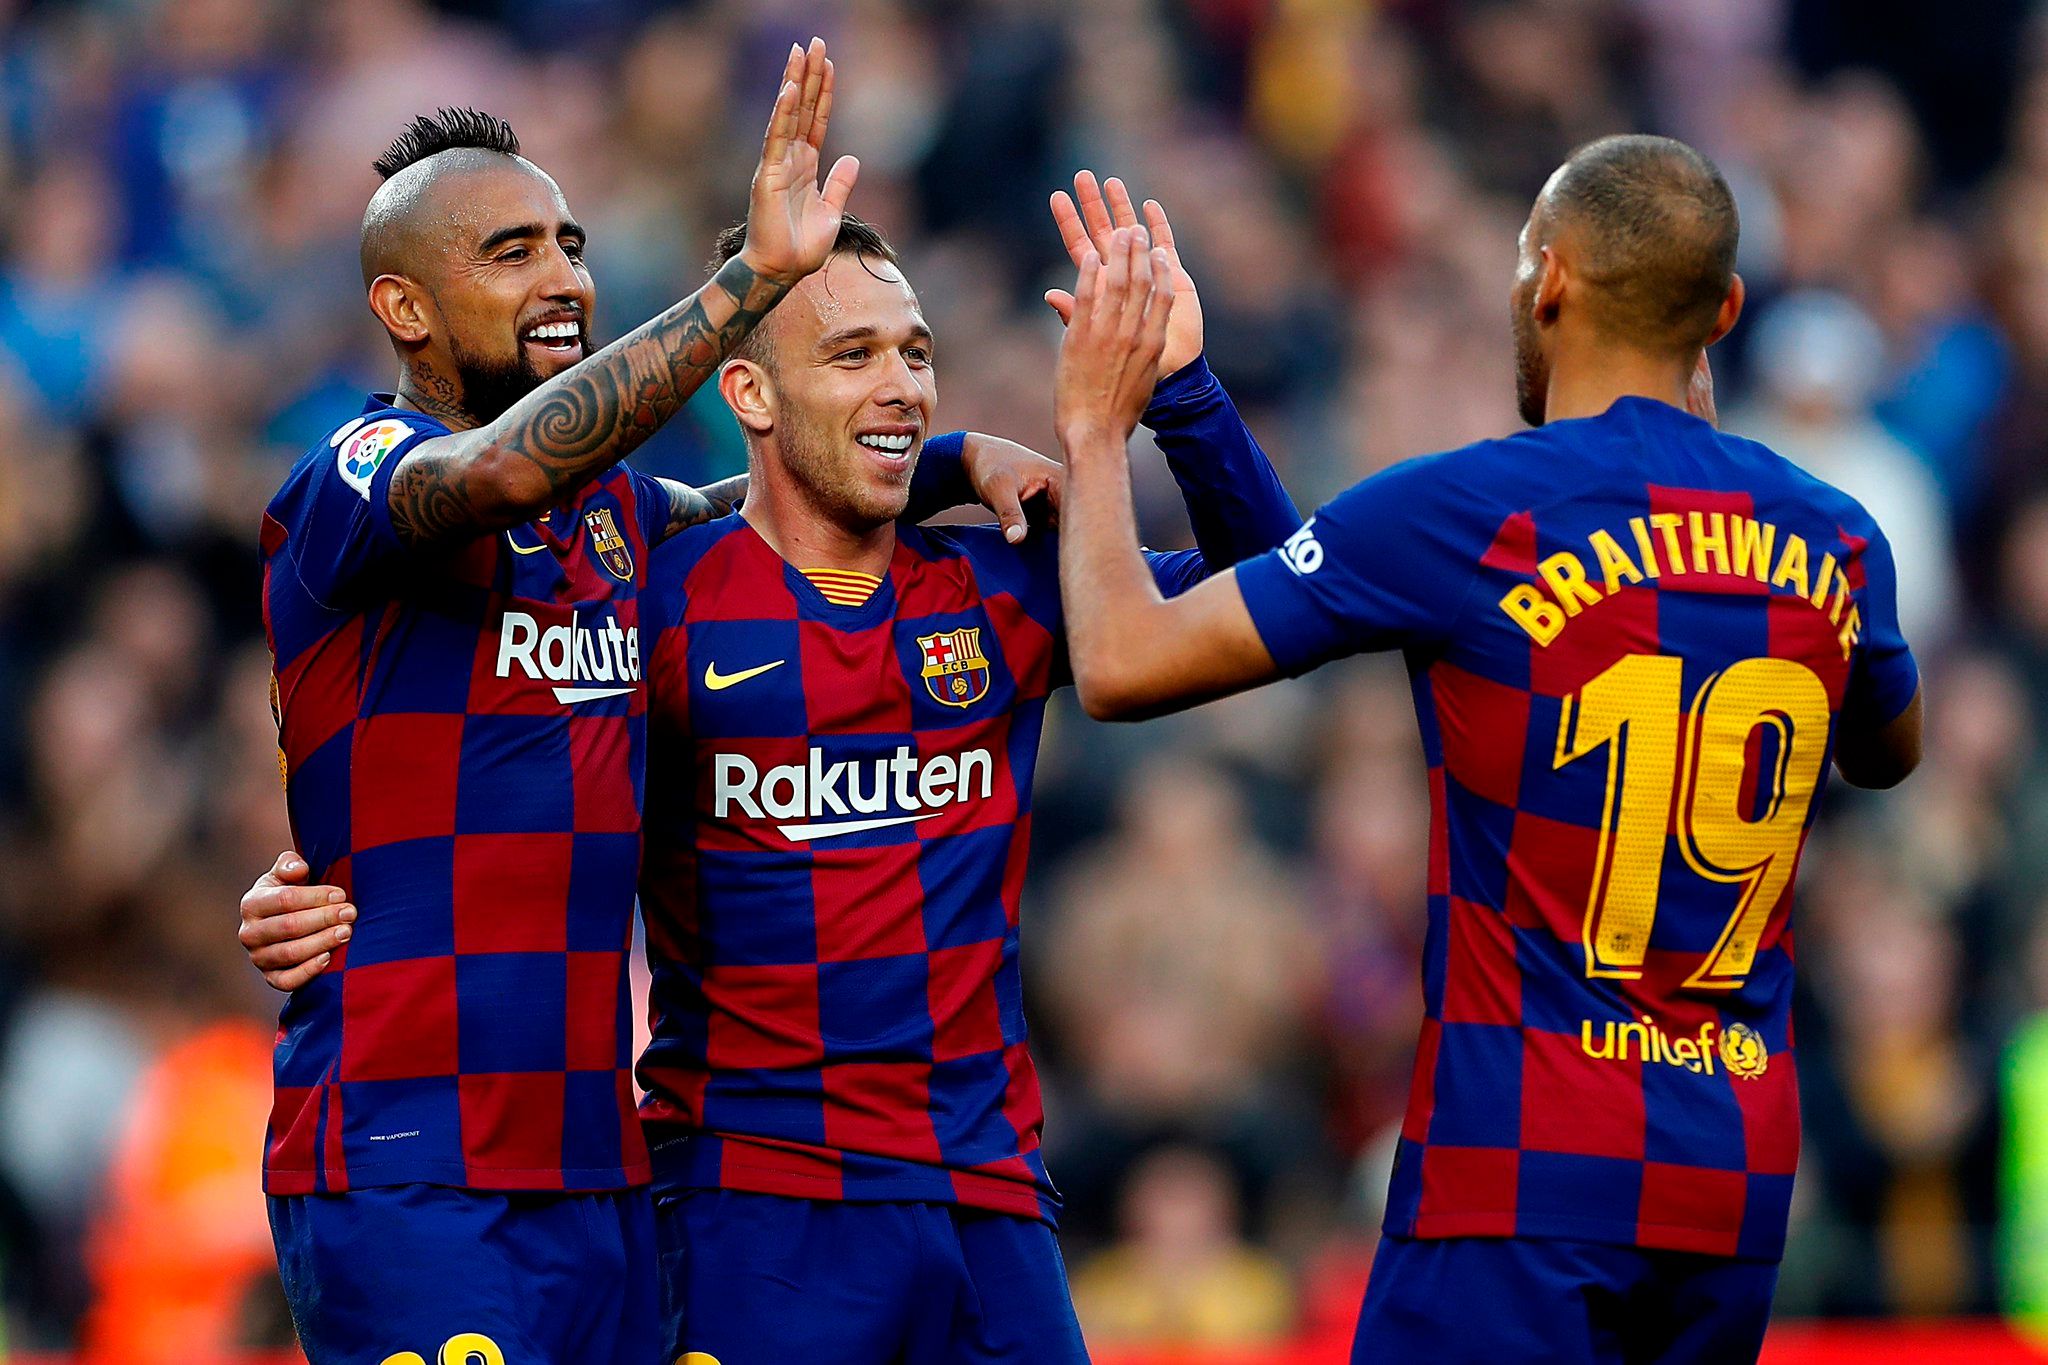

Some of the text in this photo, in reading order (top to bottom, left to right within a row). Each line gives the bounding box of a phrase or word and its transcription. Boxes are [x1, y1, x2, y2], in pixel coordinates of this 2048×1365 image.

[1284, 516, 1324, 575] ko
[1499, 511, 1862, 661] BRAITHWAITE
[496, 610, 641, 682] Rakute
[942, 660, 969, 674] FCB
[715, 746, 993, 820] Rakuten
[1553, 653, 1831, 989] 19
